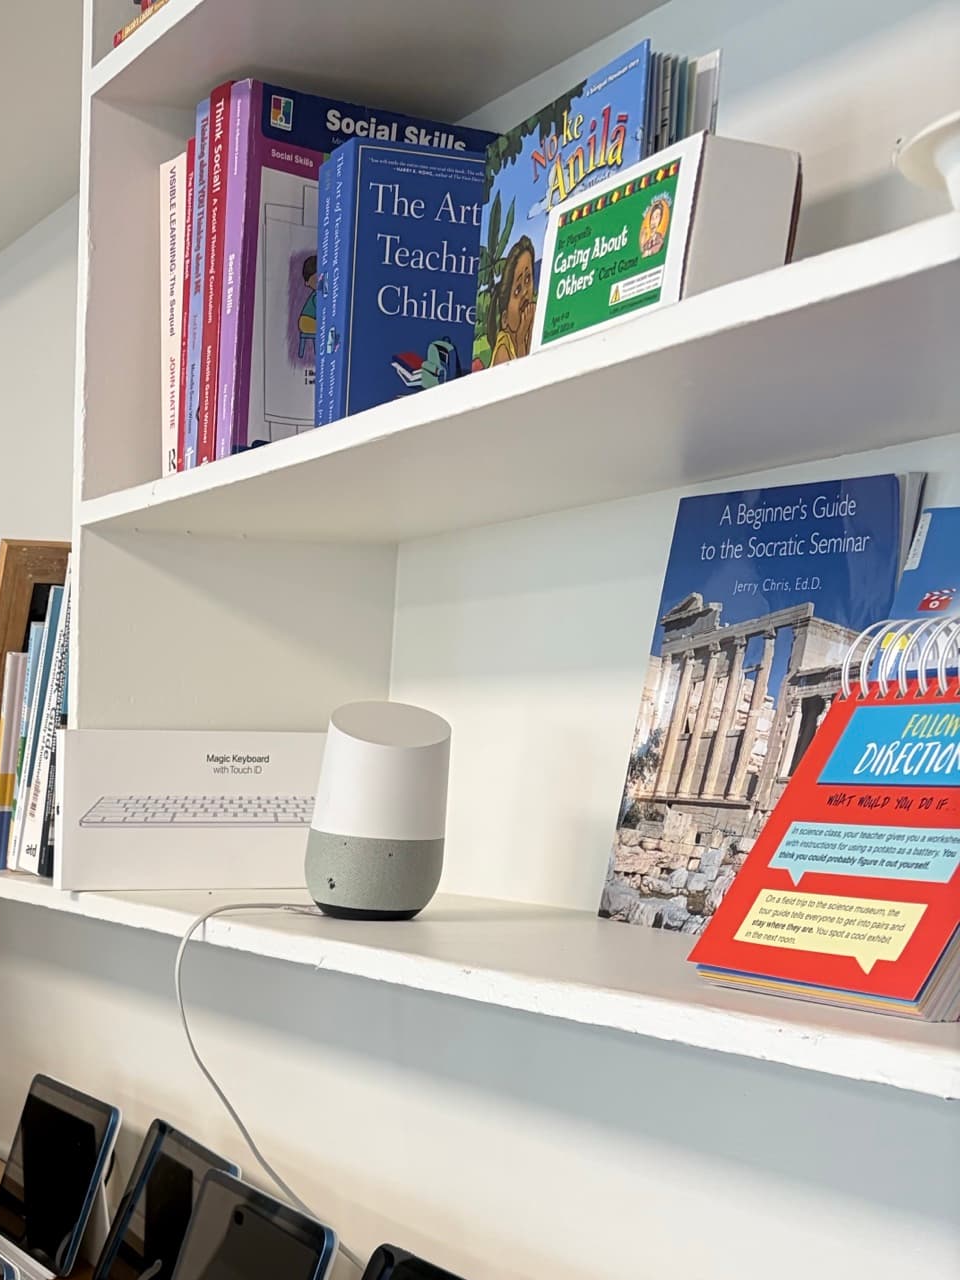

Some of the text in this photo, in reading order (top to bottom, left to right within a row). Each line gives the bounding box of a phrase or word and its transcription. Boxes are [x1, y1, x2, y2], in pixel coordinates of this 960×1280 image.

[214, 98, 224, 140] Think
[326, 109, 467, 151] Social Skills
[272, 148, 314, 168] Social Skills
[531, 109, 584, 183] No ke
[336, 153, 344, 177] The
[168, 166, 176, 211] VISIBLE
[369, 181, 482, 226] The Art
[377, 233, 480, 276] Teachin
[554, 225, 628, 274] Caring About
[226, 253, 236, 315] Social Skills
[556, 256, 638, 300] Others Card Game
[168, 299, 176, 336] Sequel
[377, 285, 477, 326] Childre
[168, 390, 176, 430] HATTIE
[720, 494, 856, 530] A Beginner's Guide
[700, 530, 870, 560] to the Socratic Seminar
[733, 576, 822, 596] Jerry Chris, Ed.D.
[44, 706, 56, 760] Guide
[206, 754, 270, 764] Magic Keyboard
[213, 766, 262, 774] with Touch ID
[827, 792, 856, 808] WHAT
[858, 794, 892, 810] WOULD
[894, 796, 914, 811] YOU
[918, 796, 934, 810] DO
[799, 828, 824, 836] science
[842, 831, 860, 840] your
[860, 831, 886, 840] teacher
[885, 833, 906, 843] gives
[905, 834, 920, 844] you
[800, 841, 837, 850] instructions
[837, 842, 848, 850] for
[848, 844, 867, 854] using
[872, 846, 896, 854] potato
[912, 848, 940, 858] battery.
[943, 848, 958, 858] You
[794, 854, 808, 862] you
[808, 854, 828, 862] could
[826, 856, 857, 866] probably
[857, 857, 879, 867] figure
[766, 894, 776, 903] On
[782, 896, 796, 906] field
[796, 899, 808, 908] trip
[816, 900, 828, 908] the
[828, 903, 854, 912] science
[854, 906, 886, 916] museum,
[887, 908, 900, 917] the
[772, 910, 790, 918] guide
[790, 911, 804, 920] tells
[804, 914, 836, 924] everyone
[843, 918, 857, 926] get
[856, 920, 871, 928] into
[870, 922, 890, 930] pairs
[889, 924, 906, 932] and
[752, 919, 766, 928] stay
[766, 921, 786, 930] where
[786, 924, 801, 934] they
[801, 926, 814, 934] are.
[816, 927, 828, 936] You
[828, 930, 846, 938] spot
[867, 934, 892, 944] exhibit
[752, 931, 763, 939] the
[763, 934, 778, 942] next
[778, 936, 796, 944] room.
